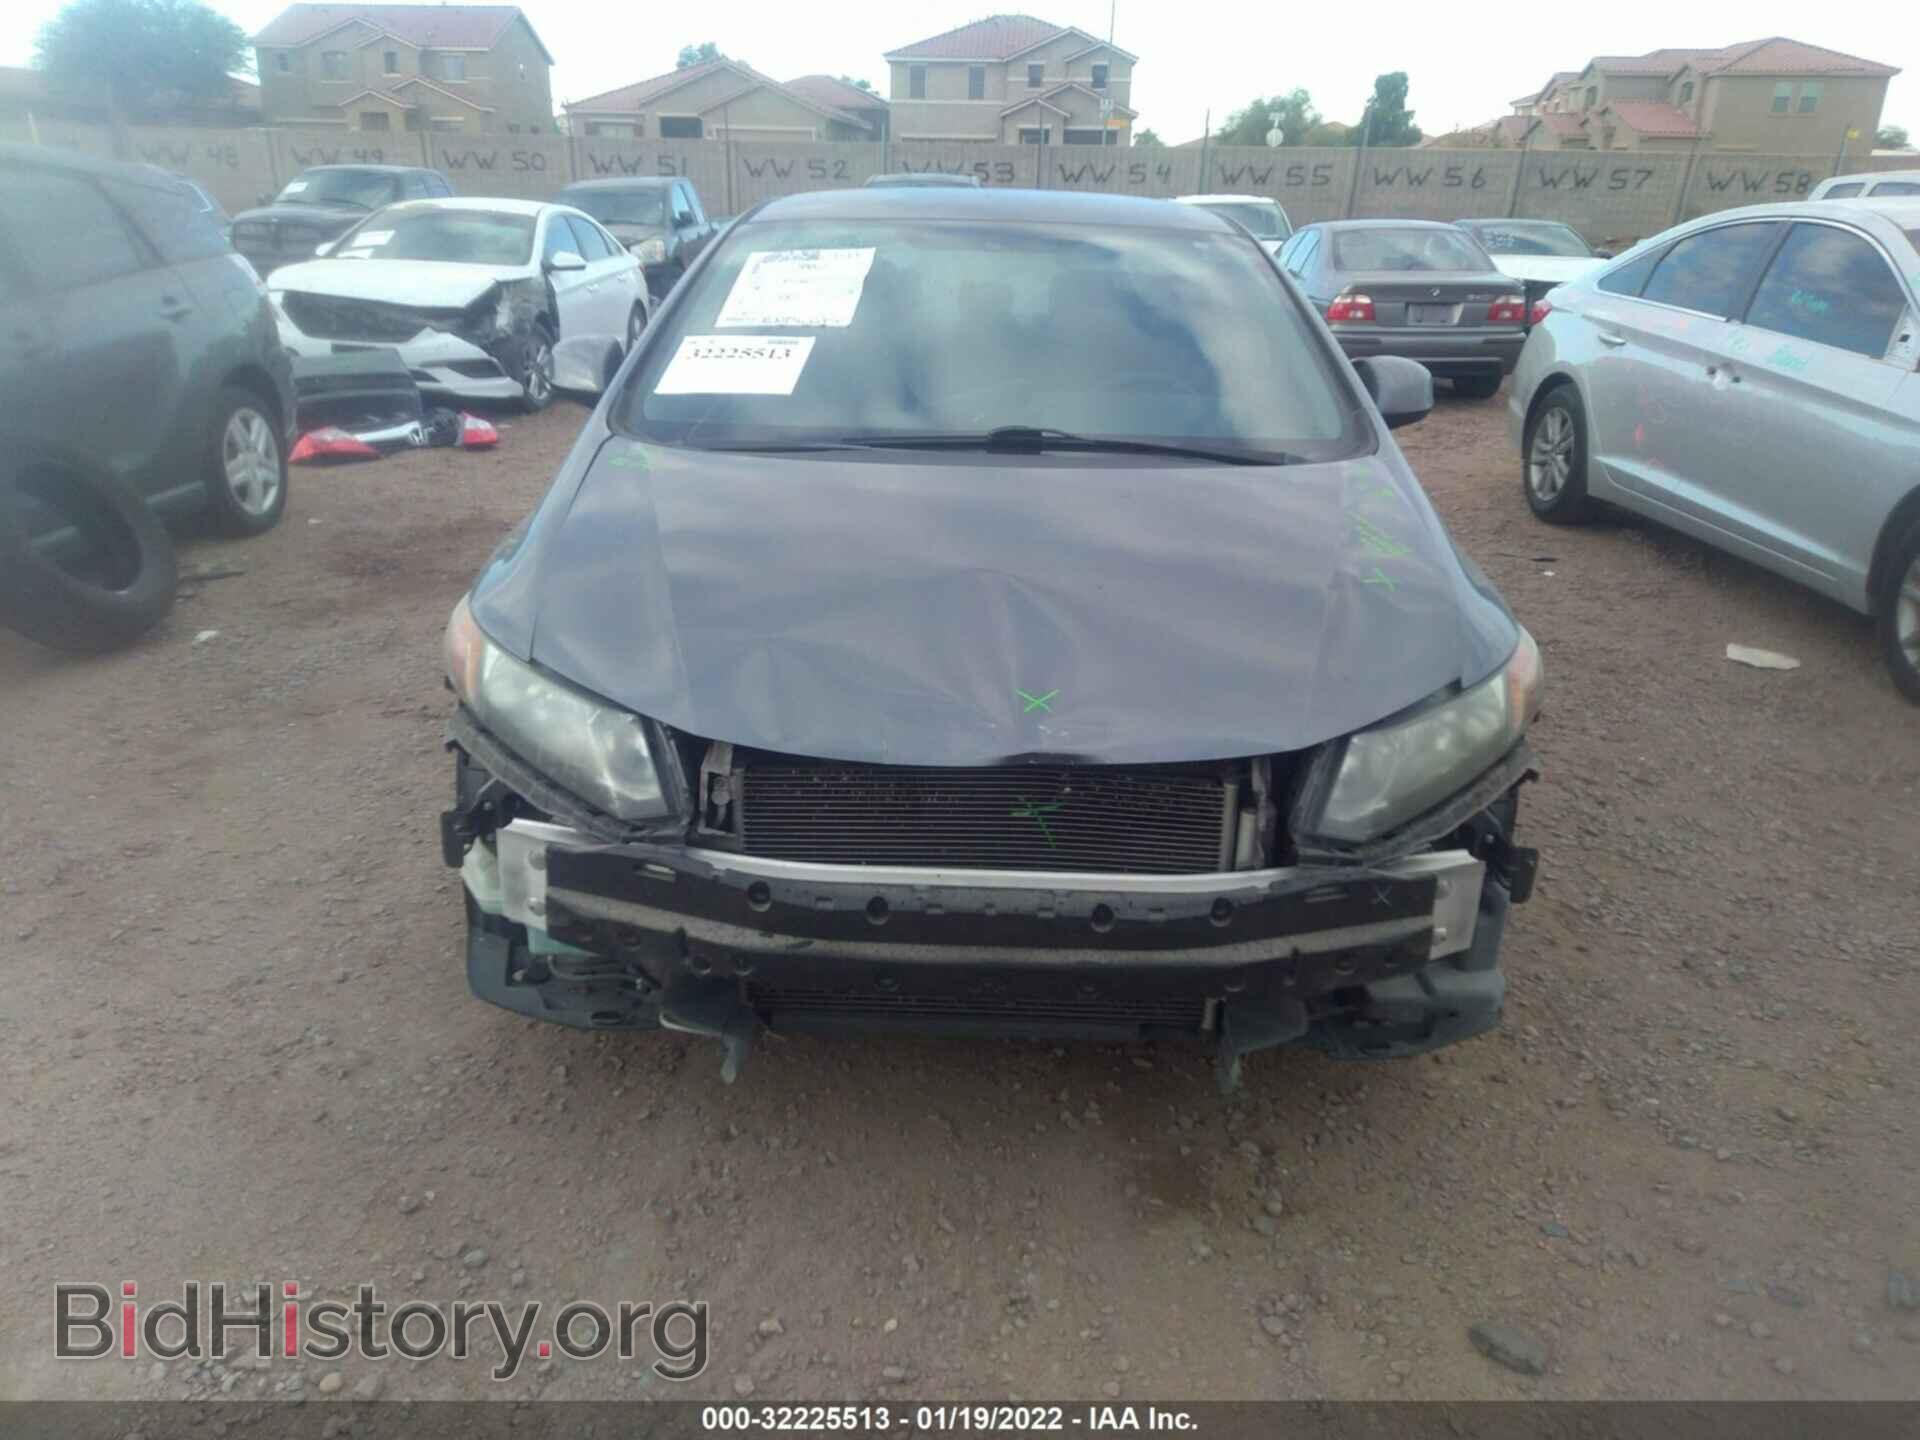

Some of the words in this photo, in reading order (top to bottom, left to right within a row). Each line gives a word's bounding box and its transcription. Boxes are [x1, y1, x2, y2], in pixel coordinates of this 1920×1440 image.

[353, 148, 384, 164] 49
[442, 150, 497, 170] WW
[511, 151, 546, 172] 50
[588, 154, 642, 175] WW
[656, 155, 688, 177] 51
[743, 159, 795, 179] WW
[808, 159, 850, 180] 52
[974, 161, 1015, 183] 53
[1058, 163, 1116, 185] WW
[1128, 163, 1171, 185] 54
[1219, 165, 1273, 186] WW
[1285, 165, 1333, 187] 55
[1373, 167, 1434, 187] WW
[1442, 167, 1487, 189] 56
[1538, 167, 1599, 189] WW
[1607, 169, 1653, 190] 57
[1706, 170, 1769, 193] WW
[1775, 171, 1810, 195] 58
